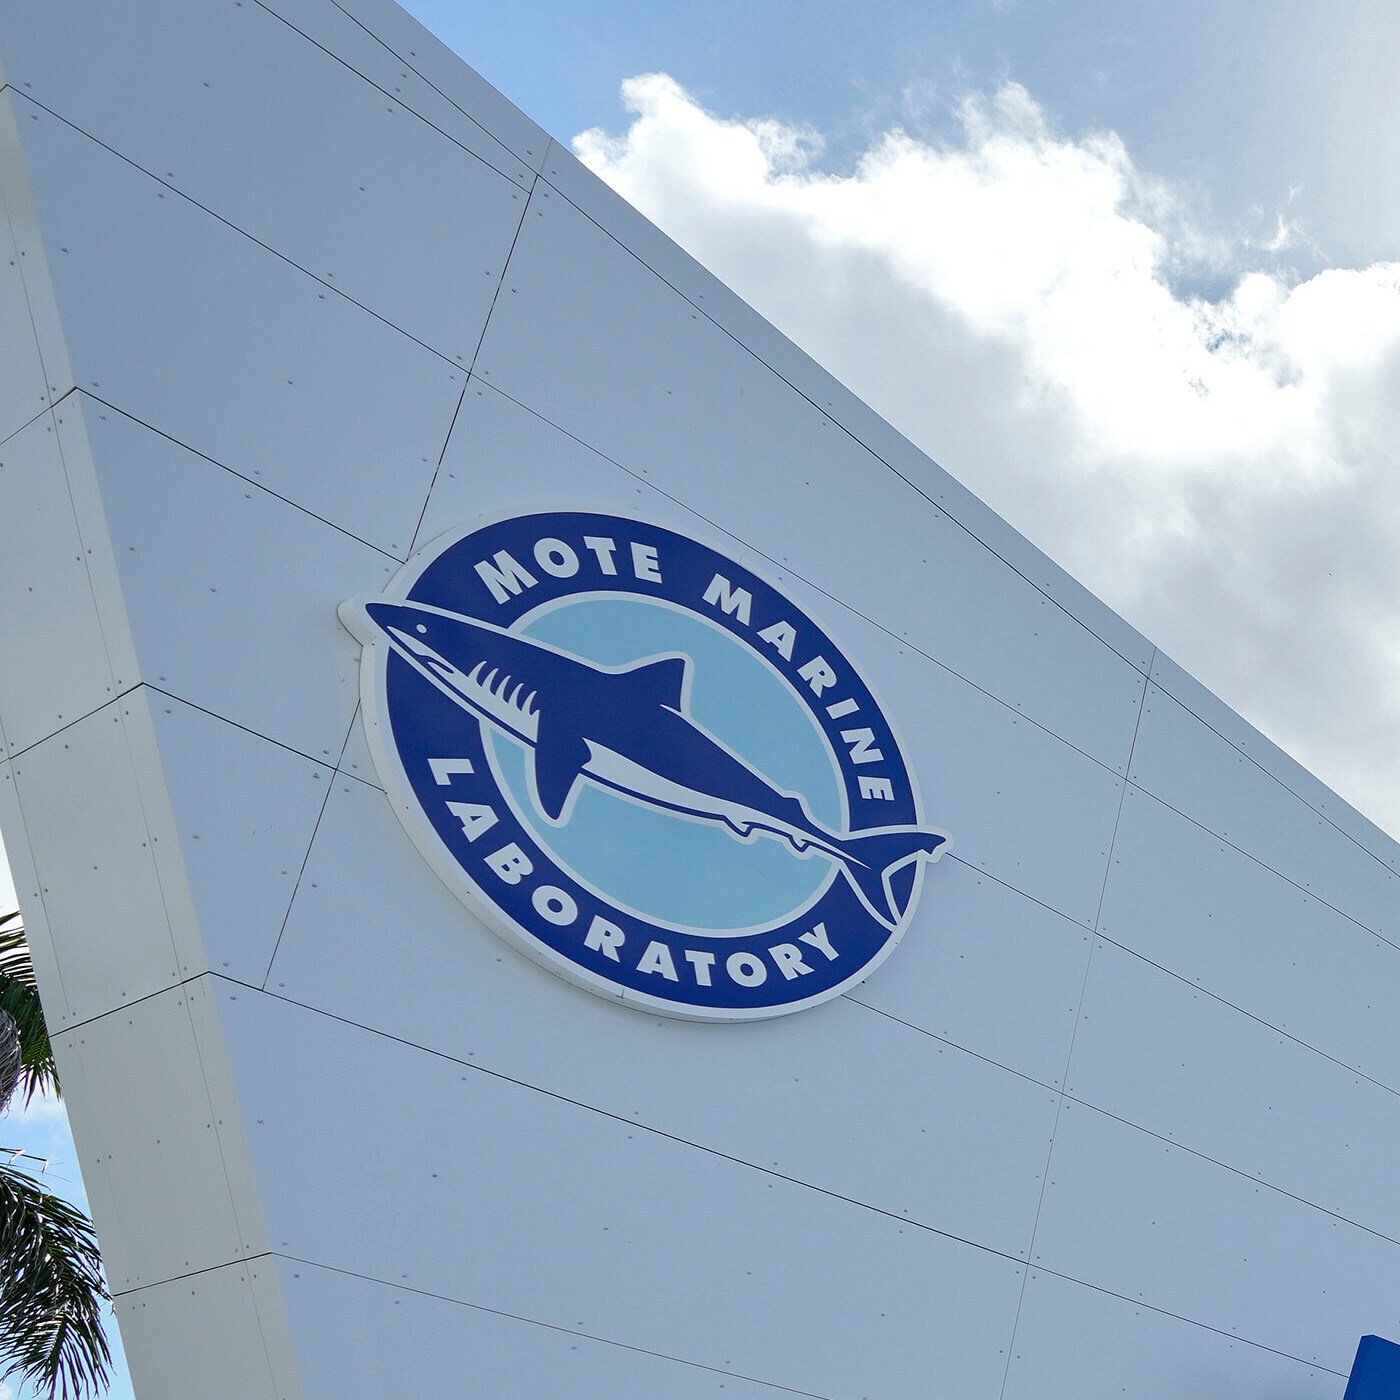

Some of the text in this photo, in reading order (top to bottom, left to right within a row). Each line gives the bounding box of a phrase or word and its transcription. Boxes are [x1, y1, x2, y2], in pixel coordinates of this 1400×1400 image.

[473, 534, 895, 802] MOTE MARINE
[427, 757, 840, 989] LABORATORY
